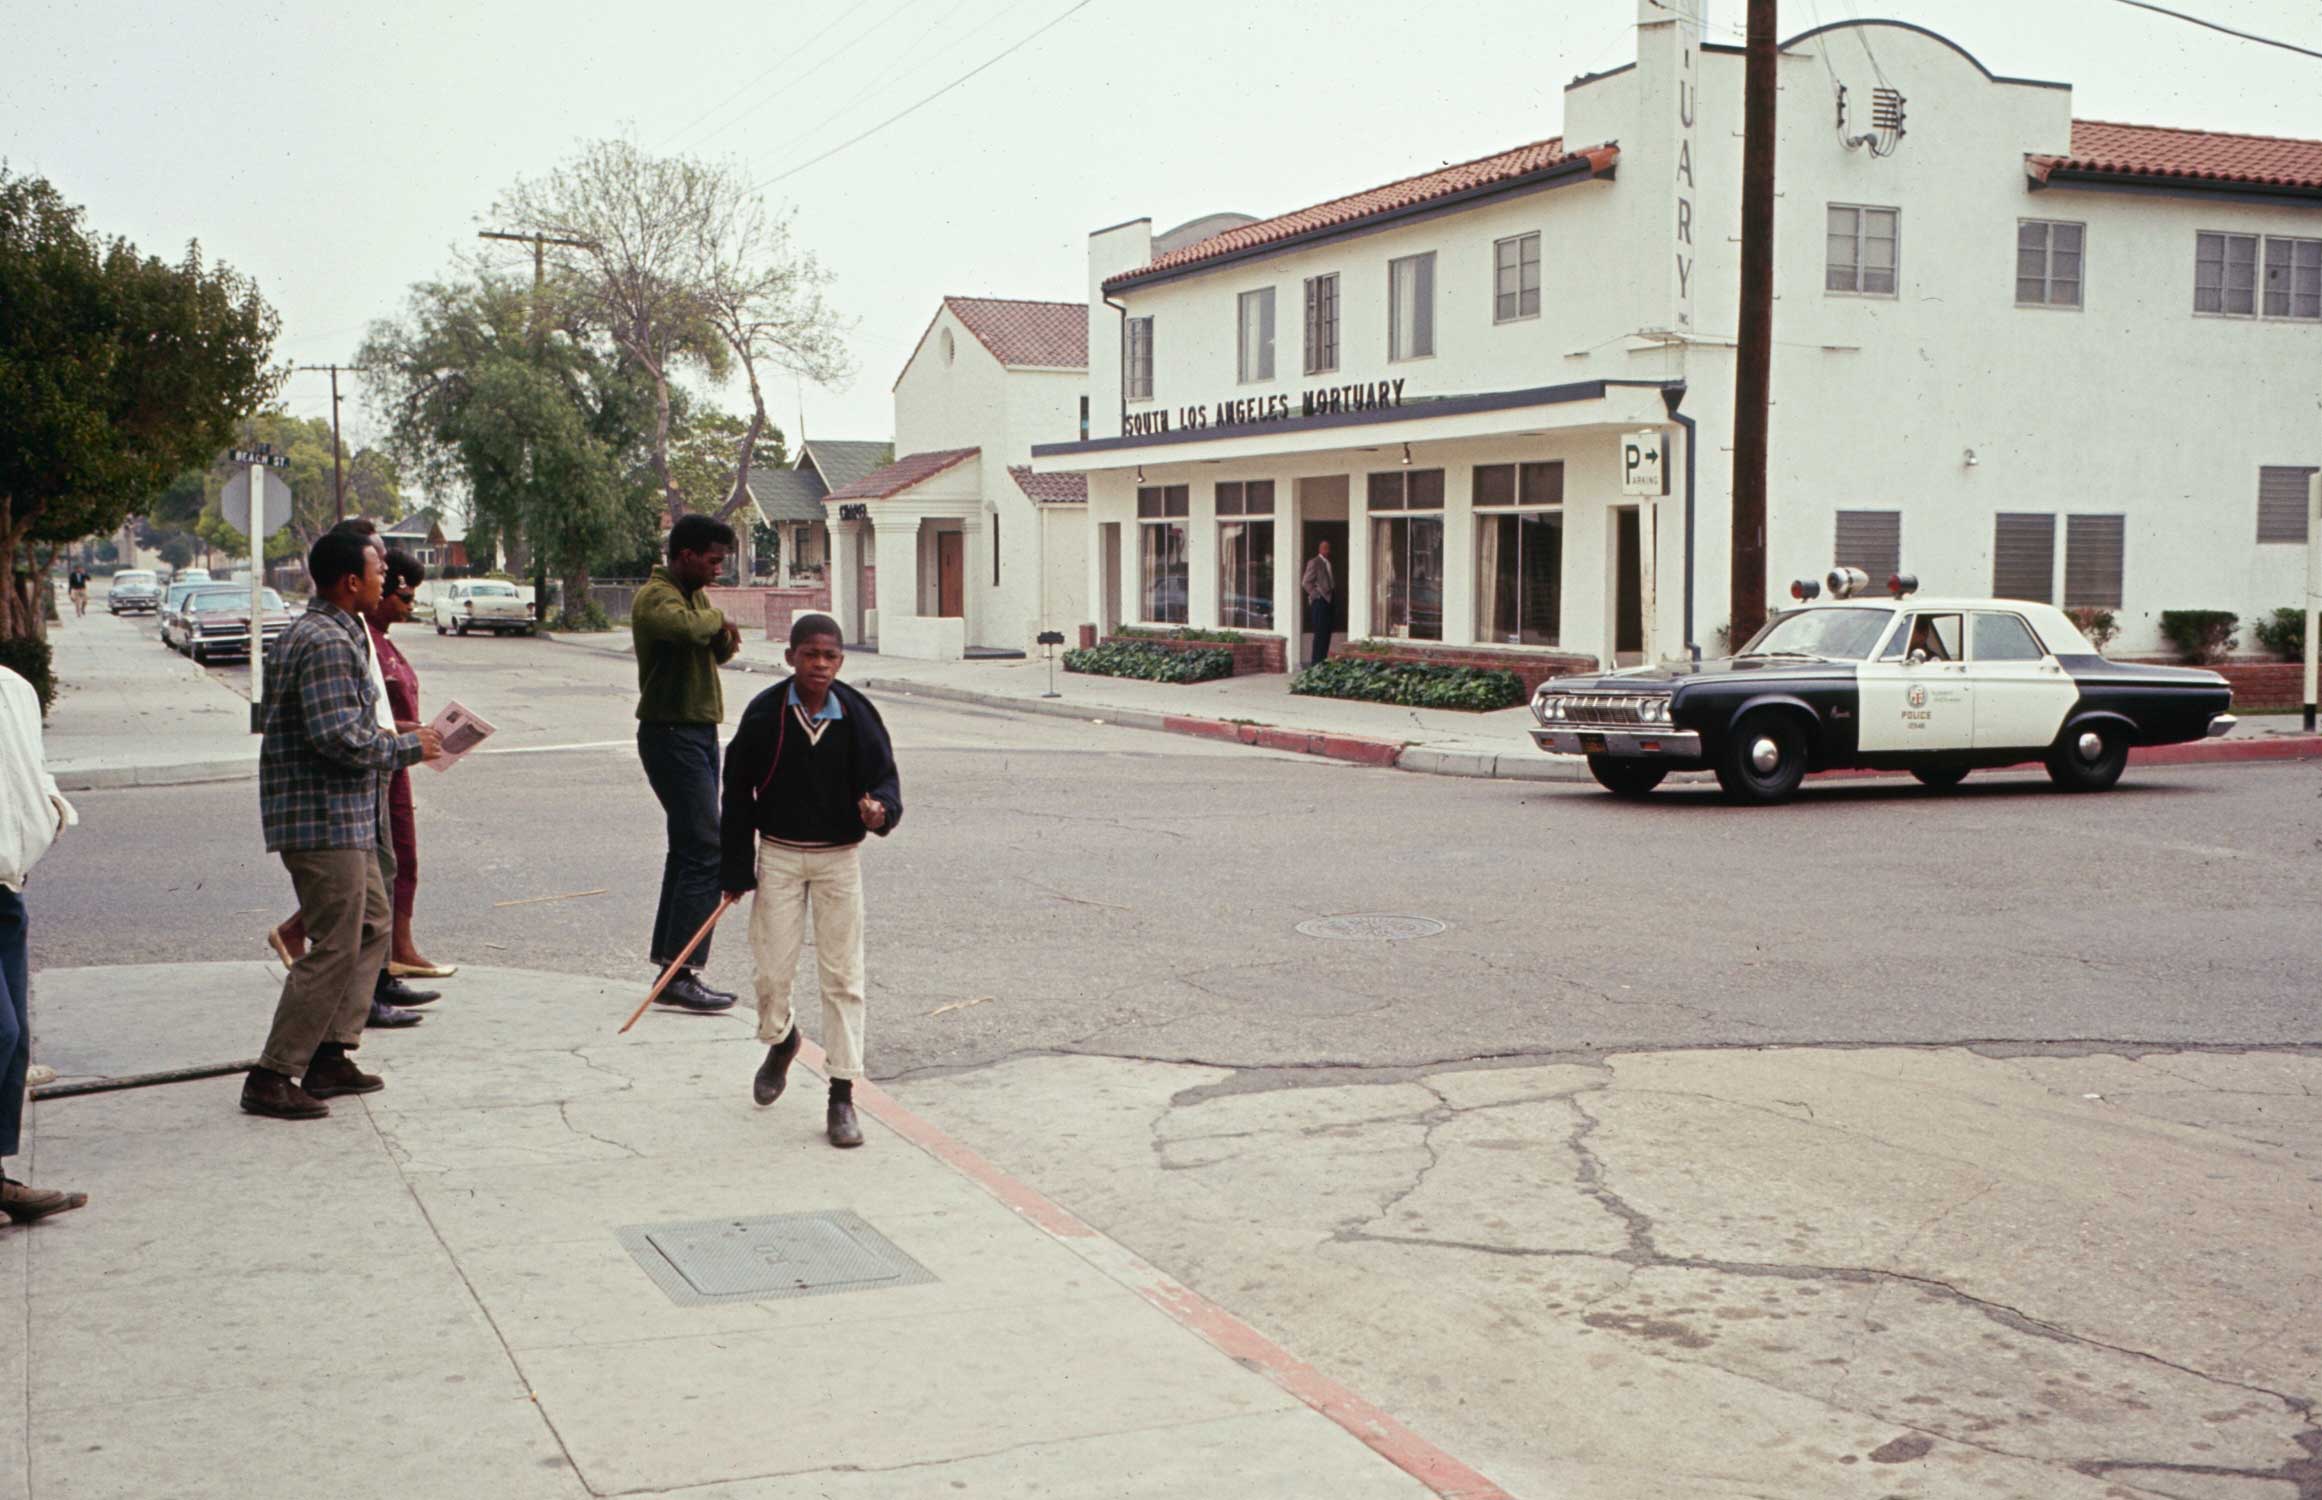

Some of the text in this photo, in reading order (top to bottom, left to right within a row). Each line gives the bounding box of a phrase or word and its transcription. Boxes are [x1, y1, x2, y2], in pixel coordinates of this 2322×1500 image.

[1125, 378, 1405, 437] SOUTH LOS ANGELES MORTUARY
[235, 450, 285, 467] BEACH ST
[1901, 710, 1932, 720] POLICE
